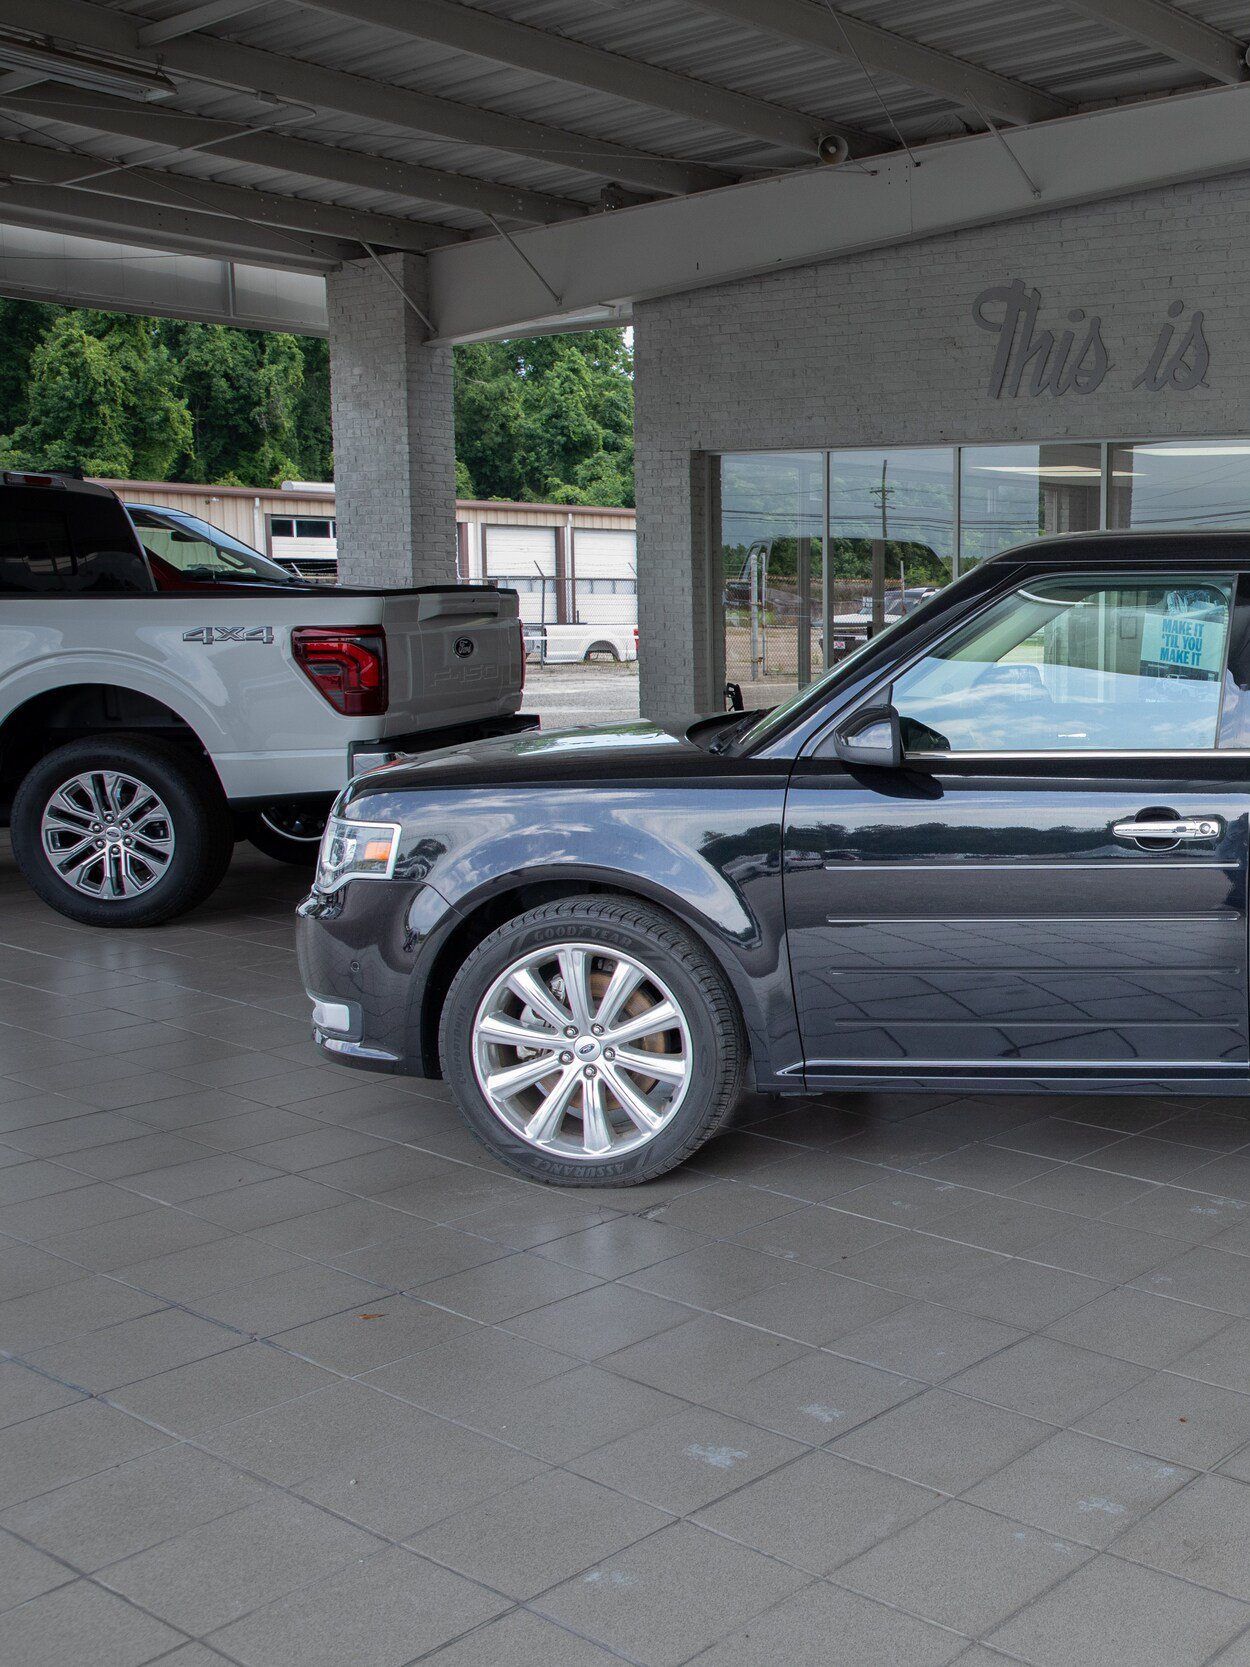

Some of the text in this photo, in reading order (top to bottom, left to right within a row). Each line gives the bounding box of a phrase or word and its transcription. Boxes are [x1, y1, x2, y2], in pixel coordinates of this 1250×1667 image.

[972, 278, 1114, 400] This
[1133, 300, 1210, 391] is
[1162, 619, 1205, 638] MAKE IT
[1183, 636, 1203, 652] YOU
[1160, 647, 1202, 666] MAKE IT
